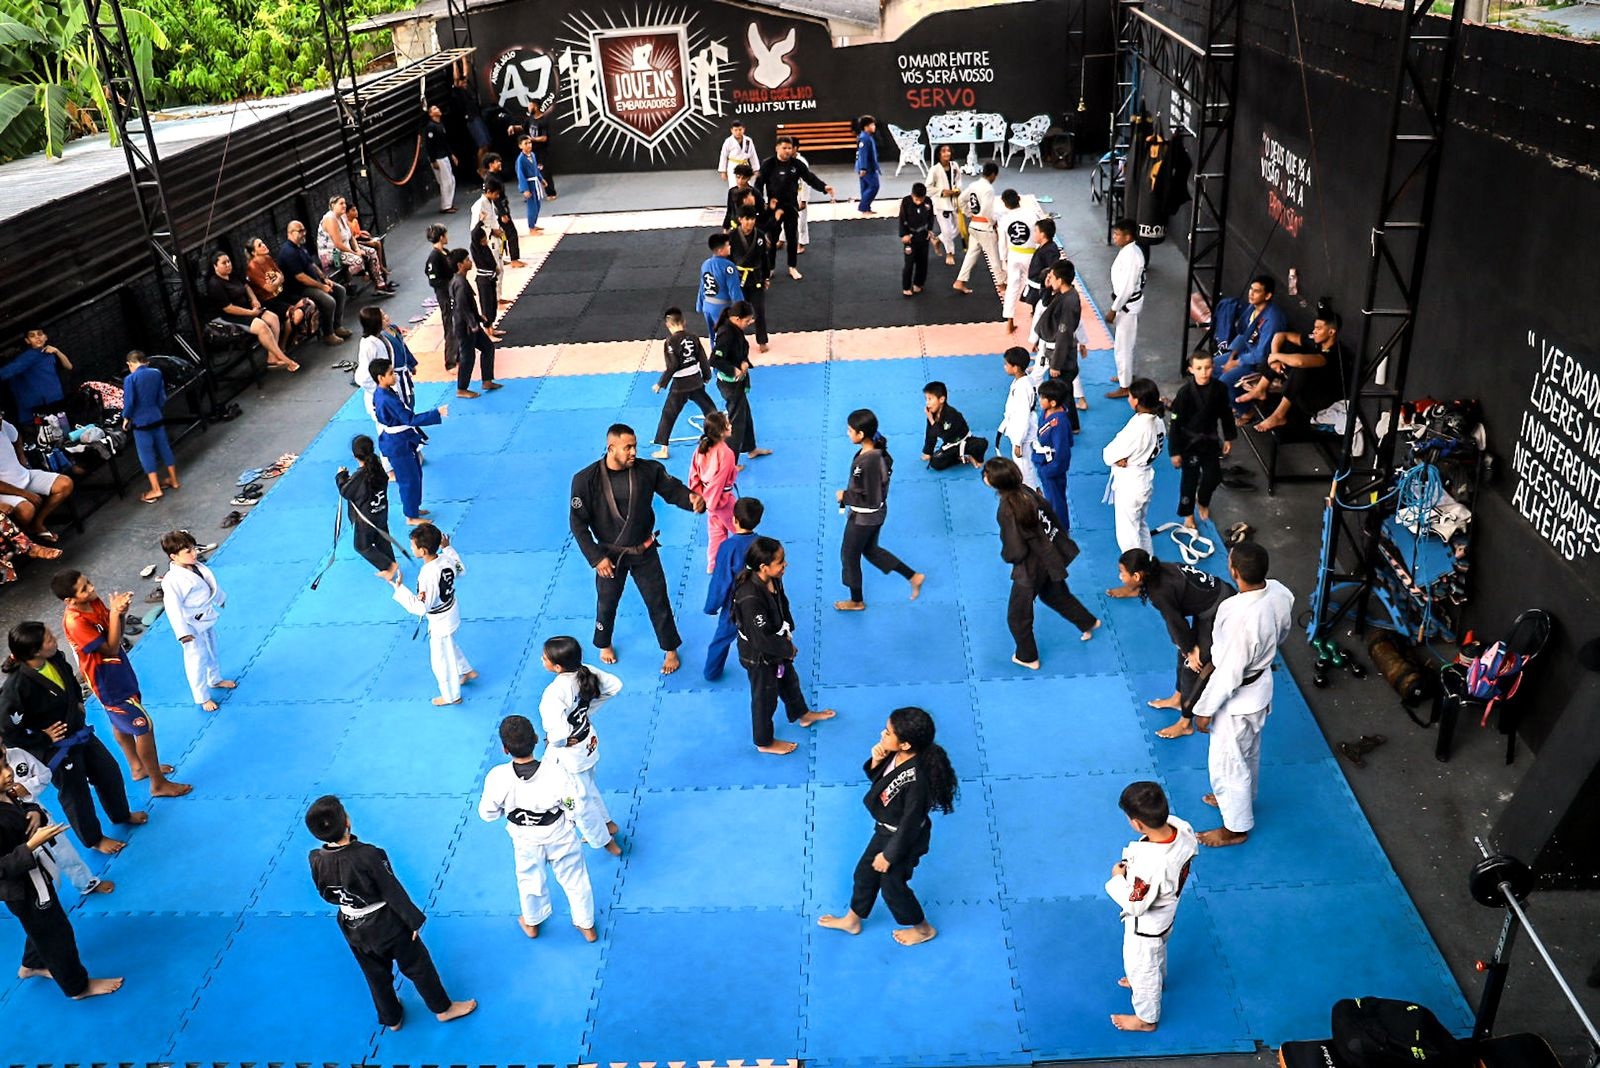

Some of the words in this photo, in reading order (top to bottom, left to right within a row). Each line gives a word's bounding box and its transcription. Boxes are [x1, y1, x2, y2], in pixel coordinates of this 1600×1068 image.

[898, 55, 907, 69] O
[909, 52, 948, 68] MAIOR
[949, 51, 990, 66] ENTRE
[613, 69, 677, 101] JOVENS
[901, 68, 924, 84] VÓS
[926, 67, 958, 84] SERÁ
[959, 68, 994, 83] VOSSO
[616, 98, 677, 111] EMBAIXADORES
[906, 87, 975, 109] SERVO
[1305, 166, 1311, 186] A
[1297, 185, 1304, 207] A
[1531, 372, 1584, 443] LÍDERES
